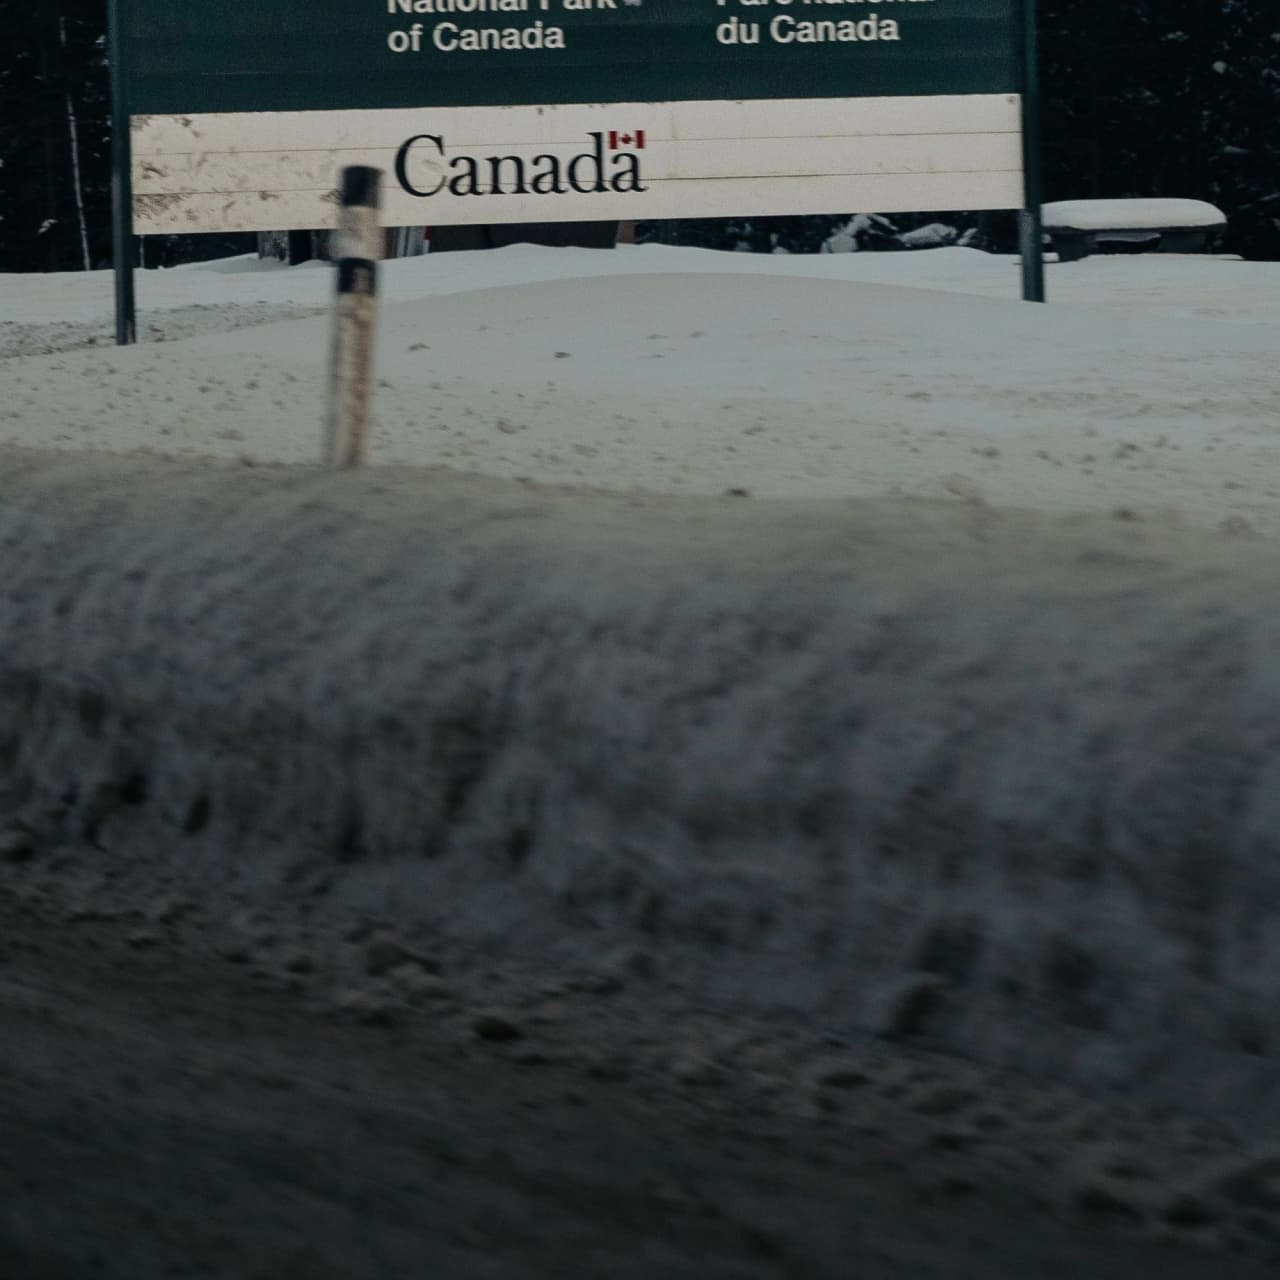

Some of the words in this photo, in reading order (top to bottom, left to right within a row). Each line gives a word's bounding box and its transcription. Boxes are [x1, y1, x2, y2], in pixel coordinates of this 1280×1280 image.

[387, 21, 423, 53] of
[432, 20, 566, 51] Canada
[716, 15, 760, 45] du
[770, 13, 901, 44] Canada
[394, 131, 649, 198] Canada
